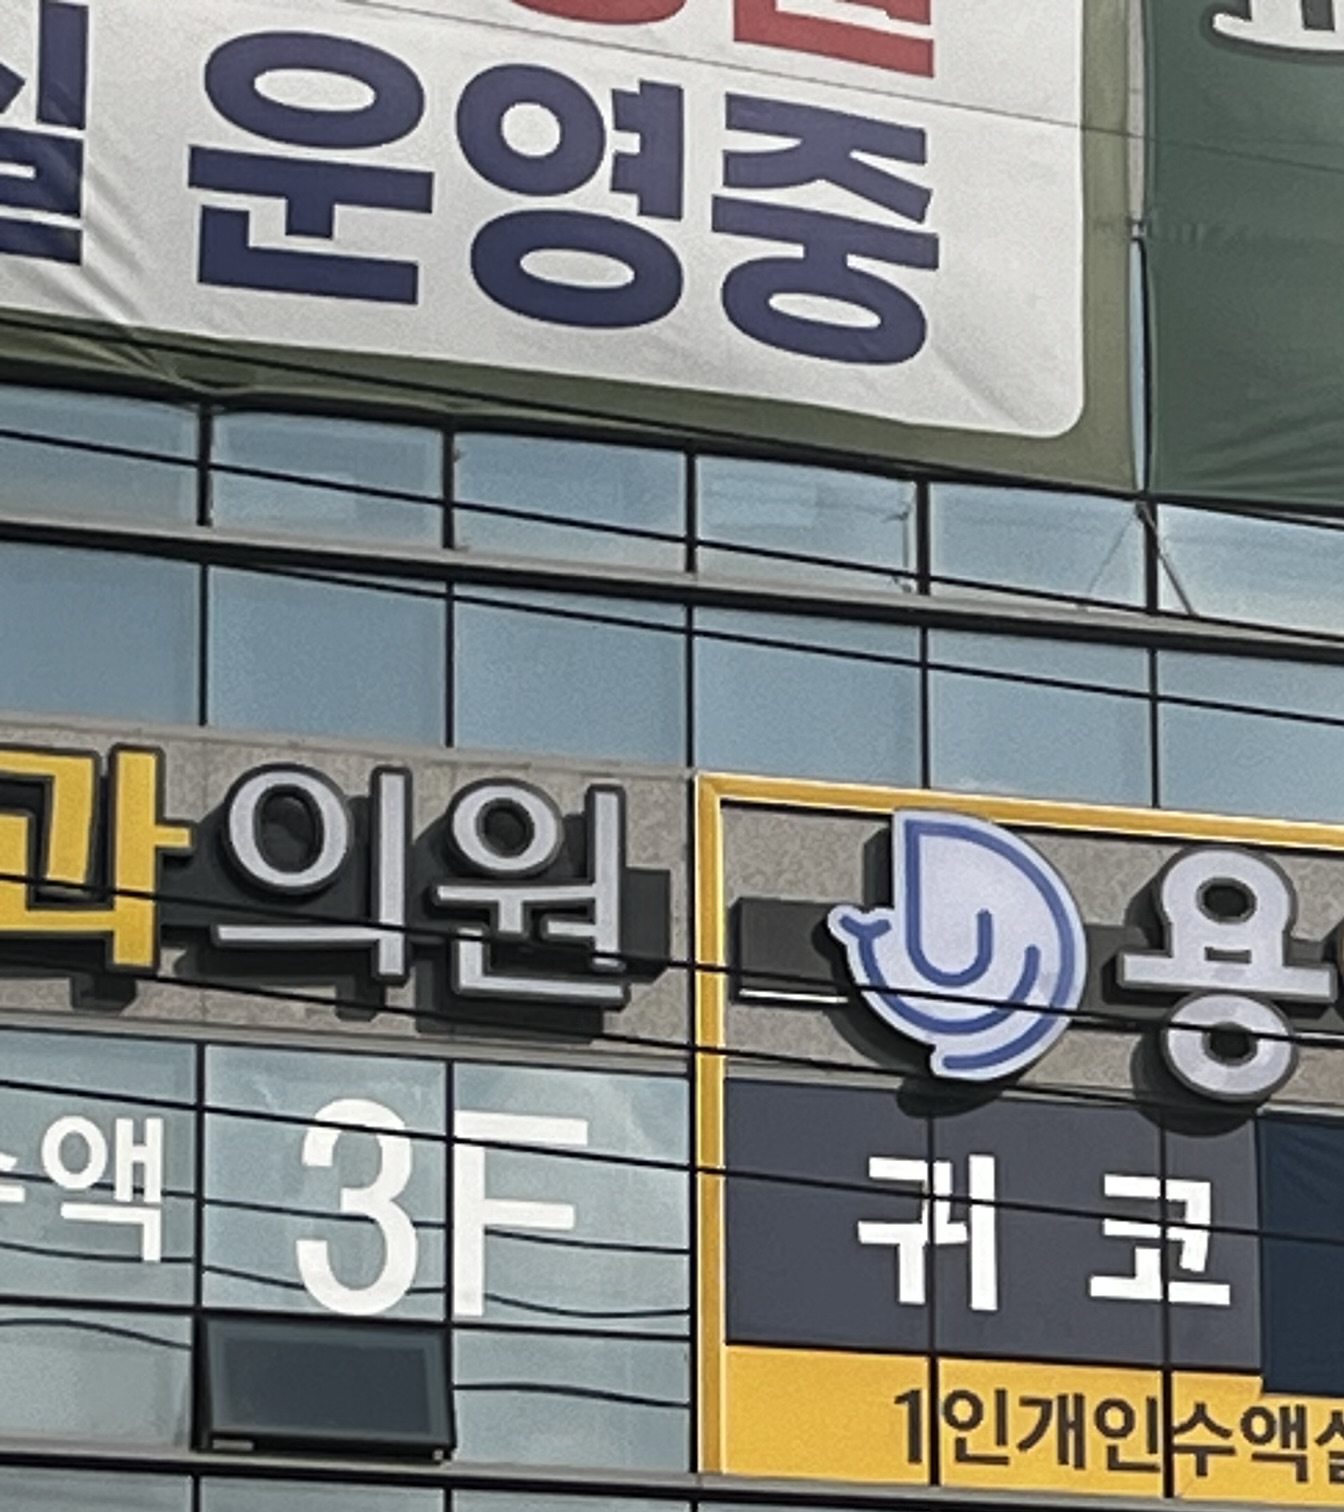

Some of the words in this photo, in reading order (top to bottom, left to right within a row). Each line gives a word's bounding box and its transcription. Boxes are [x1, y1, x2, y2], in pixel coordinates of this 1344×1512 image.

[188, 30, 940, 366] 운영중
[0, 746, 629, 1006] 과의원
[0, 1114, 164, 1262] 액
[296, 1099, 588, 1316] 3F
